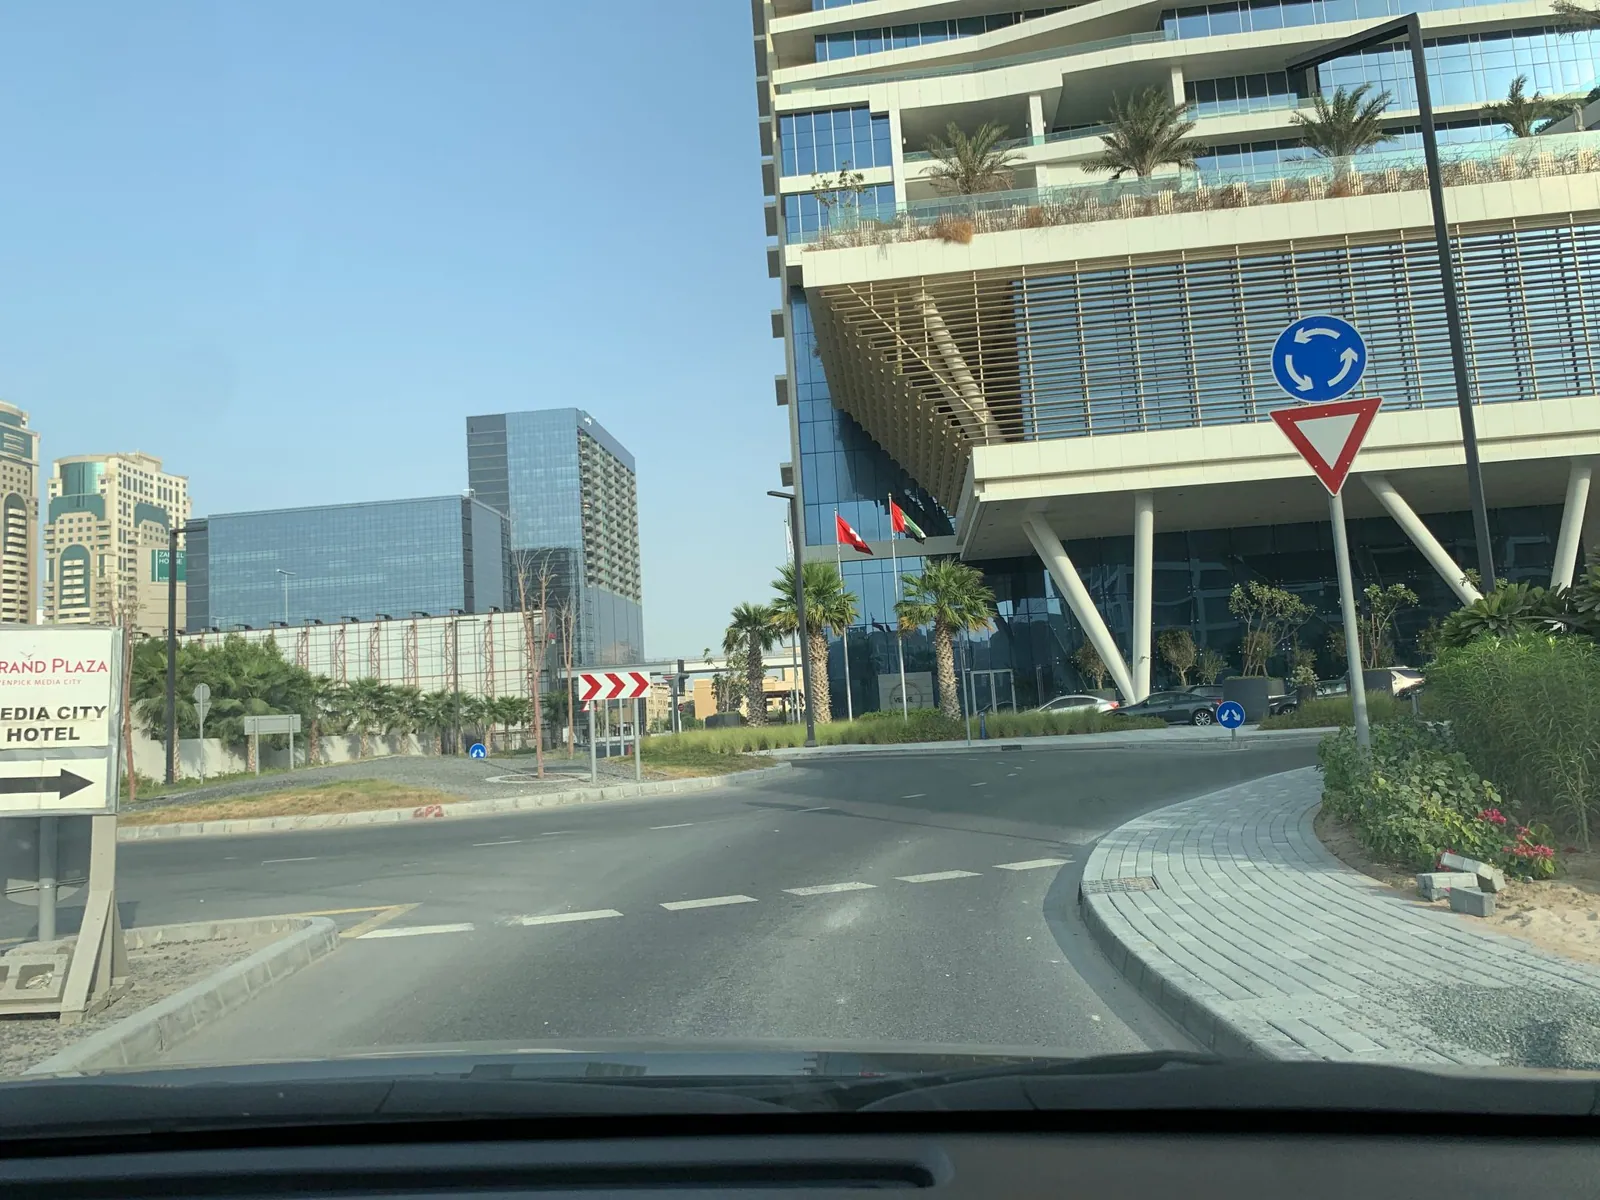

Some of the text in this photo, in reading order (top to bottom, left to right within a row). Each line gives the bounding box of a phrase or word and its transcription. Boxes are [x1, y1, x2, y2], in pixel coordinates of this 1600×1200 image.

[52, 658, 108, 673] PLAZA
[57, 705, 107, 720] CITY
[6, 727, 80, 742] HOTEL
